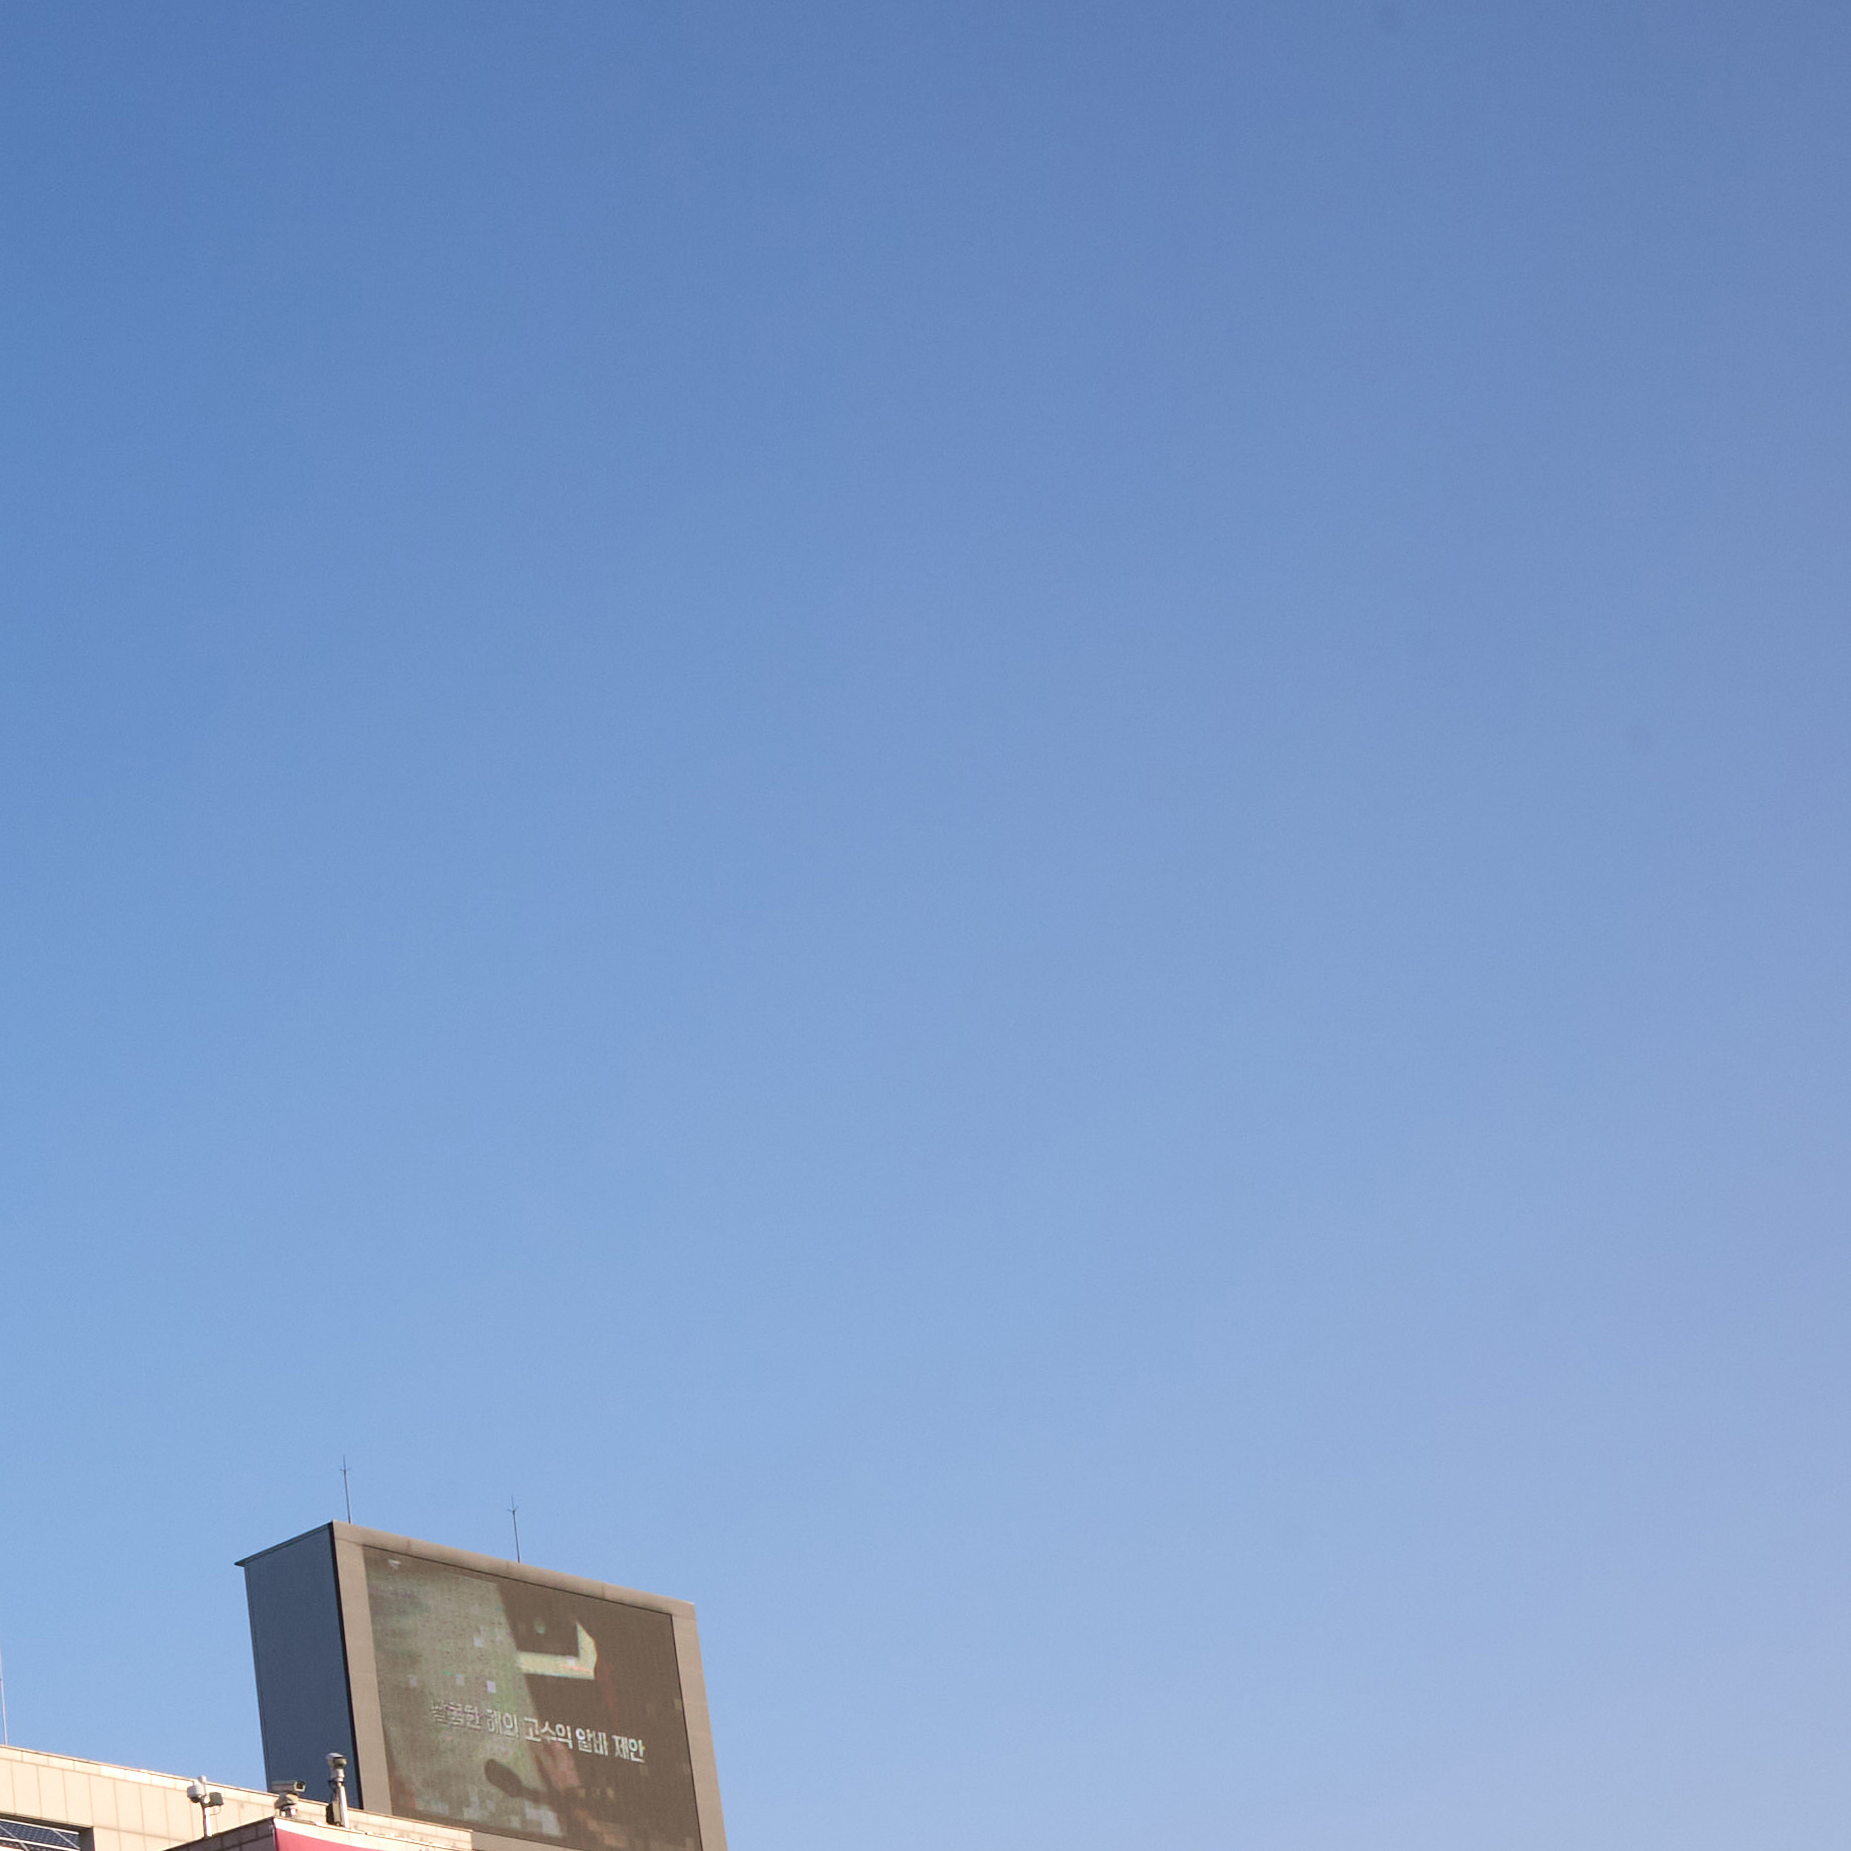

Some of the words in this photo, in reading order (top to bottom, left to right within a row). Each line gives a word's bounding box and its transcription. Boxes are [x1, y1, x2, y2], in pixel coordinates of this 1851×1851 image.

[486, 1708, 519, 1738] 해외
[524, 1716, 573, 1749] 고수익
[576, 1728, 608, 1756] 알바
[611, 1735, 645, 1763] 제안
